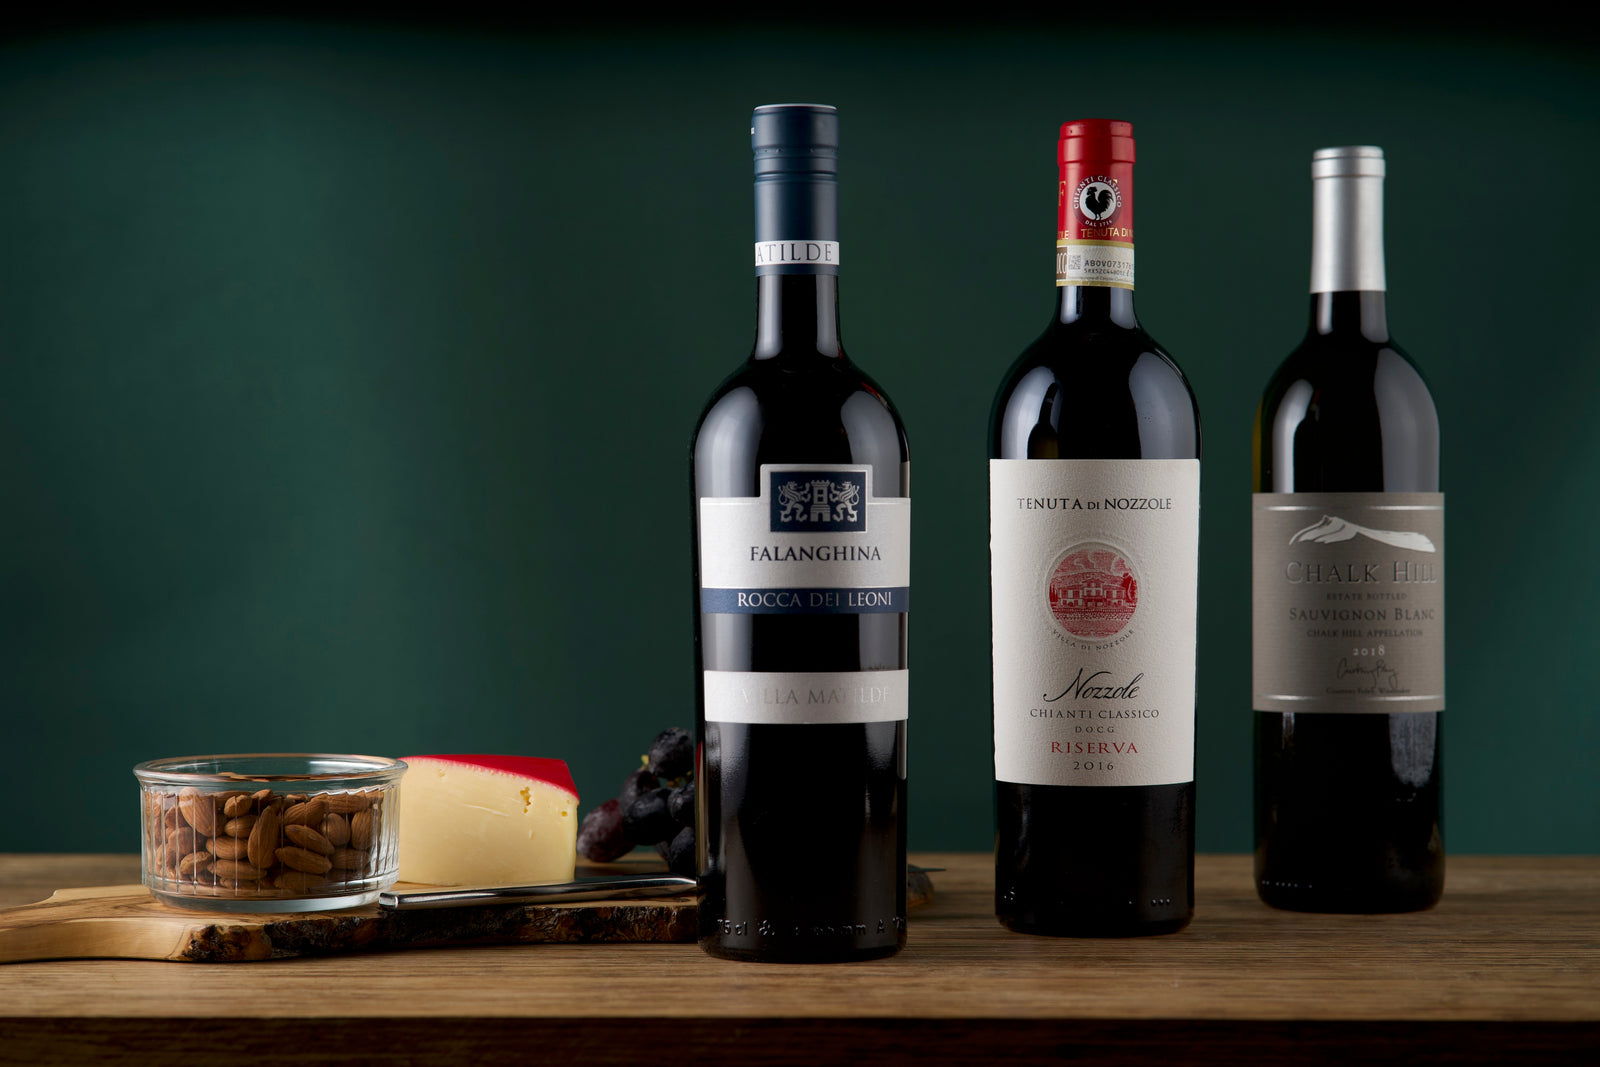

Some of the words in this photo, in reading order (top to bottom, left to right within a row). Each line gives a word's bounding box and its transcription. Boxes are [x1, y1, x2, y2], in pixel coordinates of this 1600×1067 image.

[1073, 175, 1094, 209] CHIANTI
[1097, 175, 1122, 208] CLASSICO
[1080, 228, 1120, 238] TENUTA
[756, 242, 832, 263] ATILDE
[1017, 498, 1083, 510] TENUTA
[1087, 501, 1100, 510] DI
[1104, 498, 1172, 510] NOZZOLE
[750, 545, 882, 561] FALANGHINA
[1285, 561, 1380, 584] CHALK
[1392, 561, 1438, 584] HILL
[737, 592, 802, 607] ROCCA
[809, 592, 840, 607] DEI
[848, 591, 893, 607] LEONI
[1288, 607, 1387, 621] SAUVIGNON
[1394, 607, 1435, 621] BLANC
[1053, 629, 1076, 648] VILLA
[1096, 629, 1135, 651] NOZZOLE
[1352, 644, 1386, 656] 2018
[1043, 667, 1145, 702] Nozzole
[741, 687, 799, 705] VLLA
[1029, 708, 1093, 719] CHIANTI
[1098, 708, 1160, 719] CLASSICO
[1050, 741, 1139, 754] RISERVA
[1073, 761, 1114, 771] 2016
